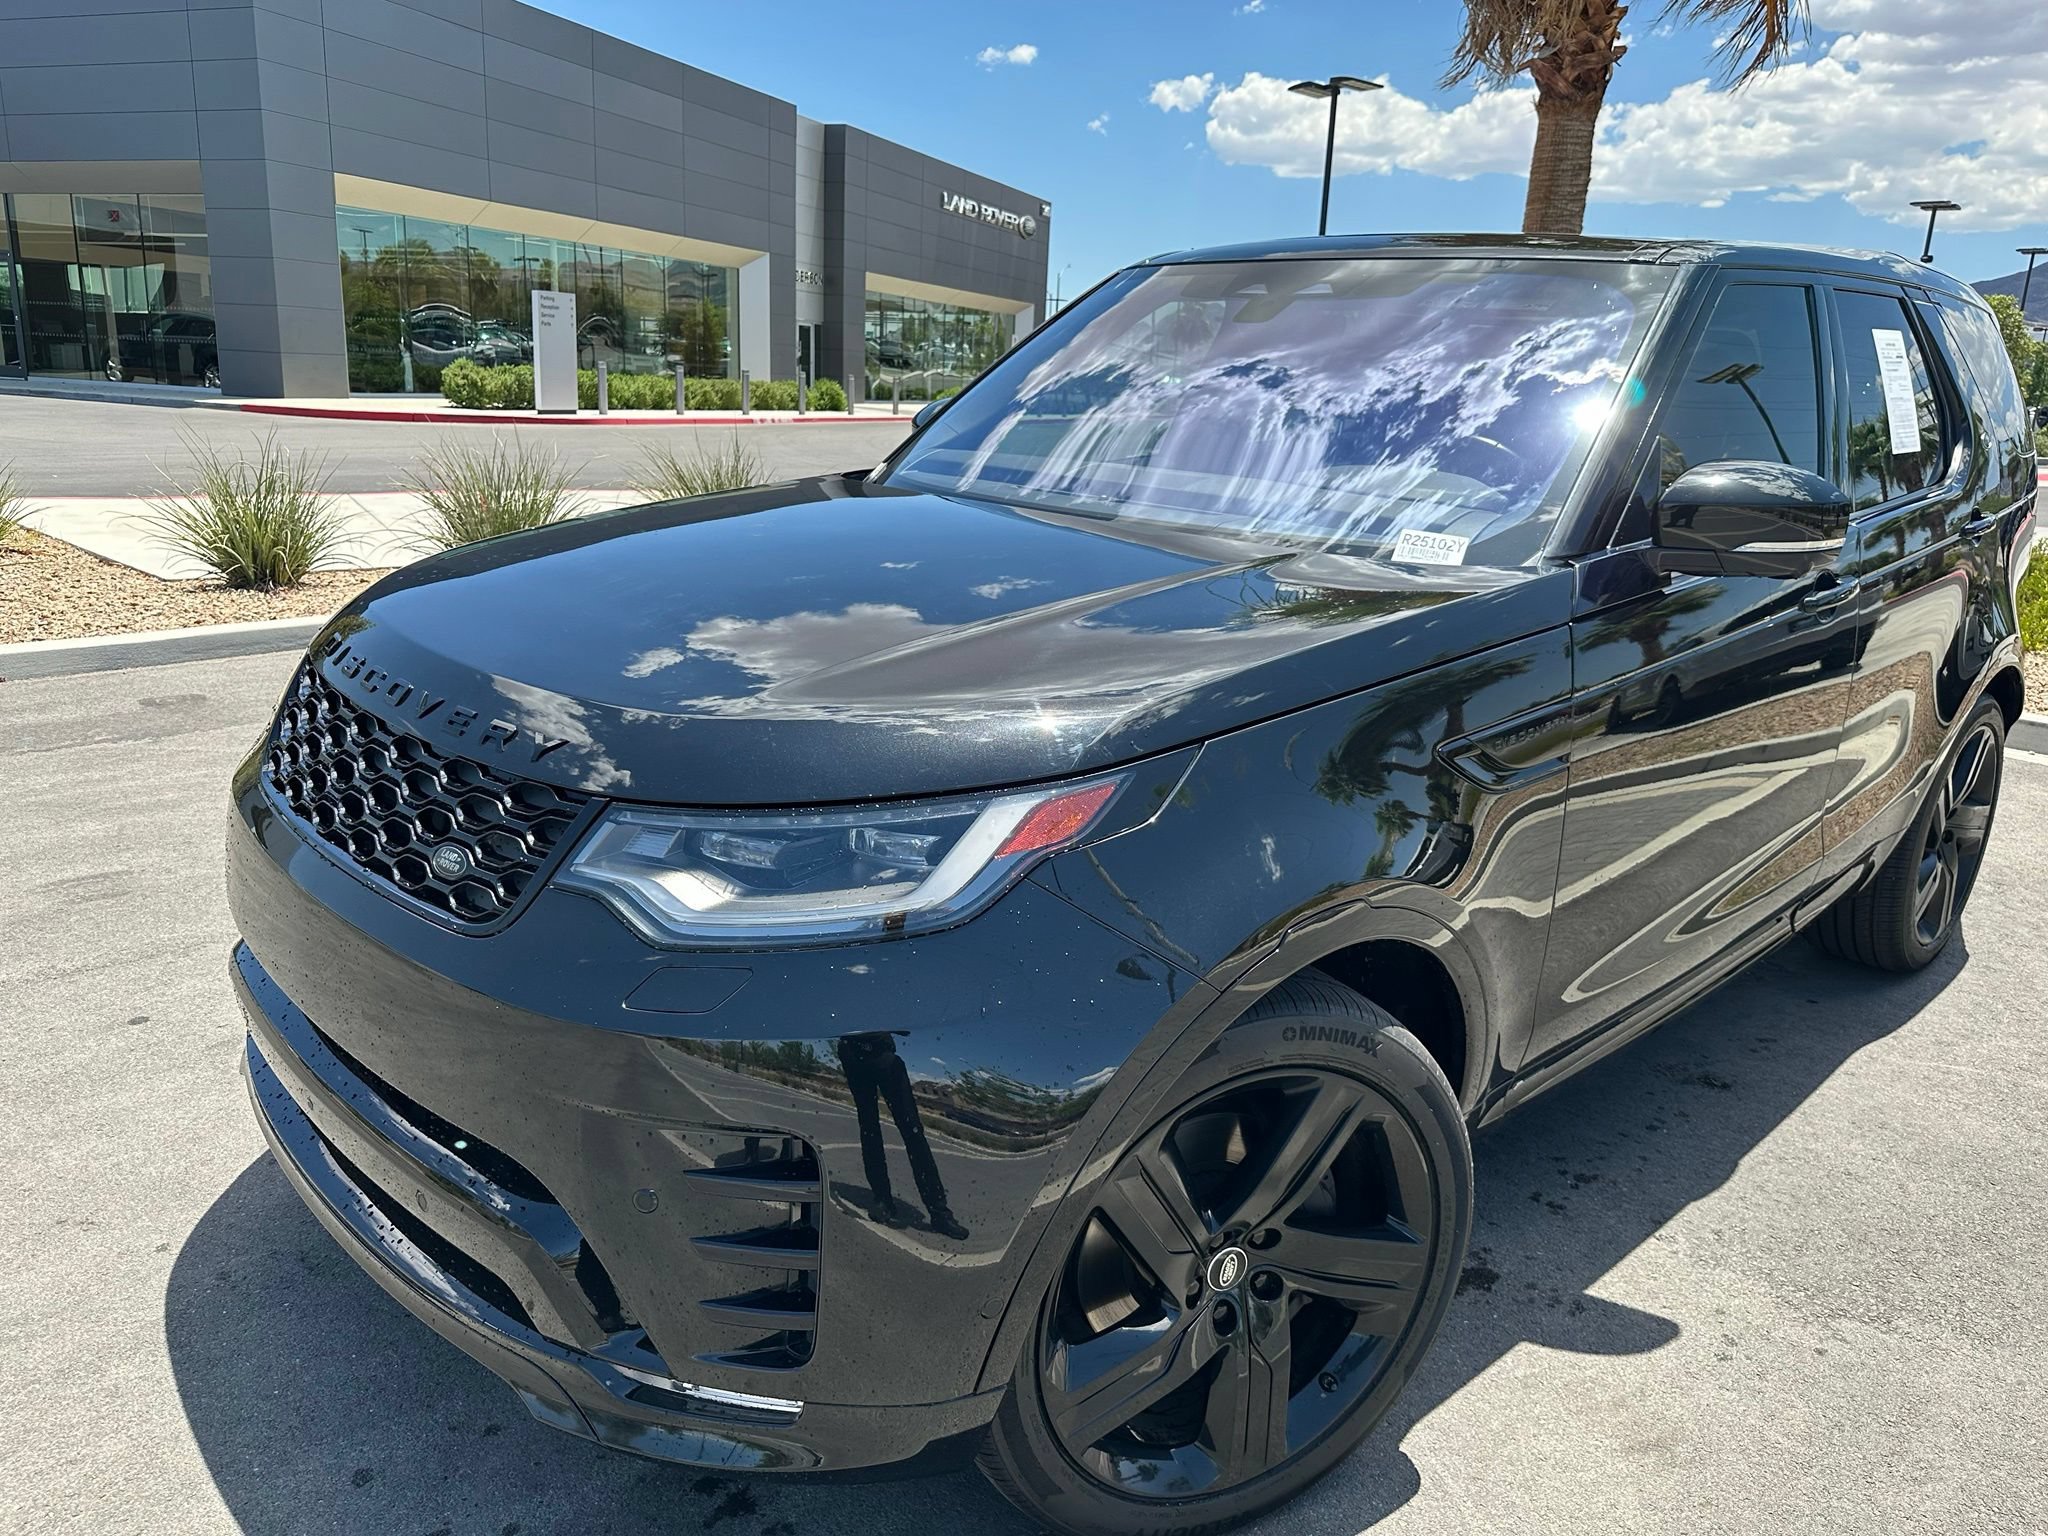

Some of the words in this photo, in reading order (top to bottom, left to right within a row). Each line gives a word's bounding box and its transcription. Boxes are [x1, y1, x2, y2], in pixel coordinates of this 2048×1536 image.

[942, 191, 979, 218] LAND
[980, 203, 1020, 232] ROVER
[1401, 533, 1466, 553] R25102Y
[323, 631, 571, 763] DISCOVERY
[439, 857, 460, 873] ROVER
[440, 848, 458, 862] LAND
[1282, 1025, 1383, 1059] OMNIMAX
